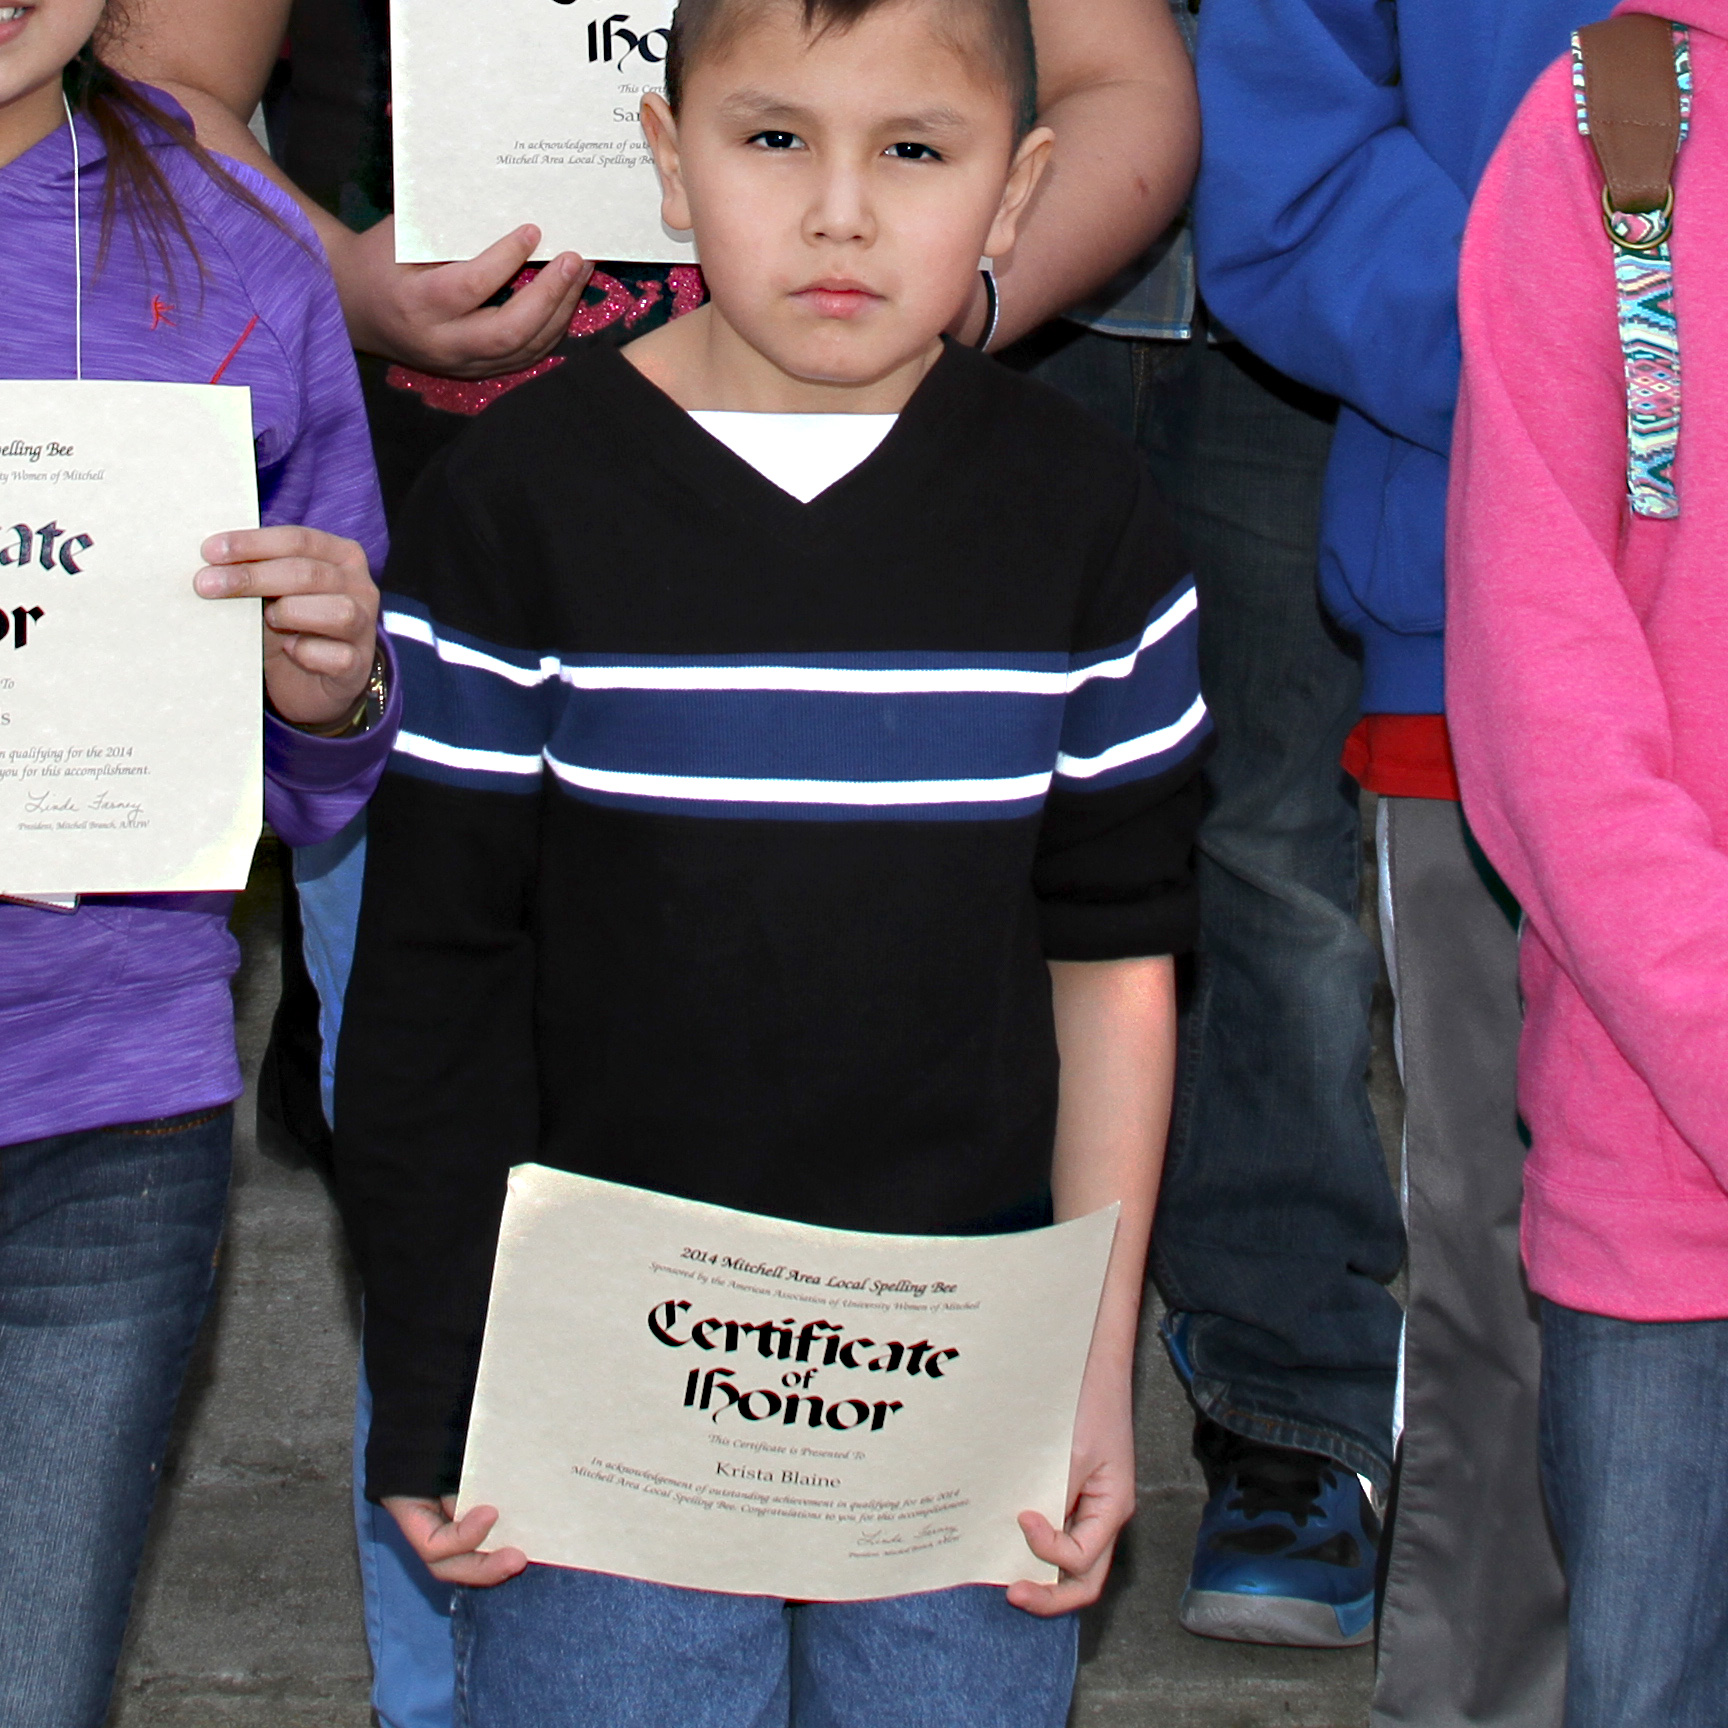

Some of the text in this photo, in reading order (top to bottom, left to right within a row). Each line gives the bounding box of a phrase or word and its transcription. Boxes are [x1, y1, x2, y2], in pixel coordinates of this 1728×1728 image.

[46, 442, 74, 457] Bee
[11, 470, 47, 481] Women
[50, 469, 62, 485] of
[62, 469, 105, 480] Mitchell
[0, 678, 14, 689] To
[9, 746, 64, 763] qualifying
[64, 746, 84, 763] for
[86, 745, 103, 758] the
[105, 747, 133, 757] 2014
[19, 765, 38, 781] for
[42, 764, 61, 776] this
[64, 763, 150, 780] accomplishment.
[680, 1247, 957, 1296] 2014 Mitchell Area Local Spelling Bee
[648, 1299, 960, 1379] Certificate
[781, 1367, 819, 1390] of
[683, 1367, 904, 1432] Honor
[716, 1461, 841, 1488] Krista Blaine
